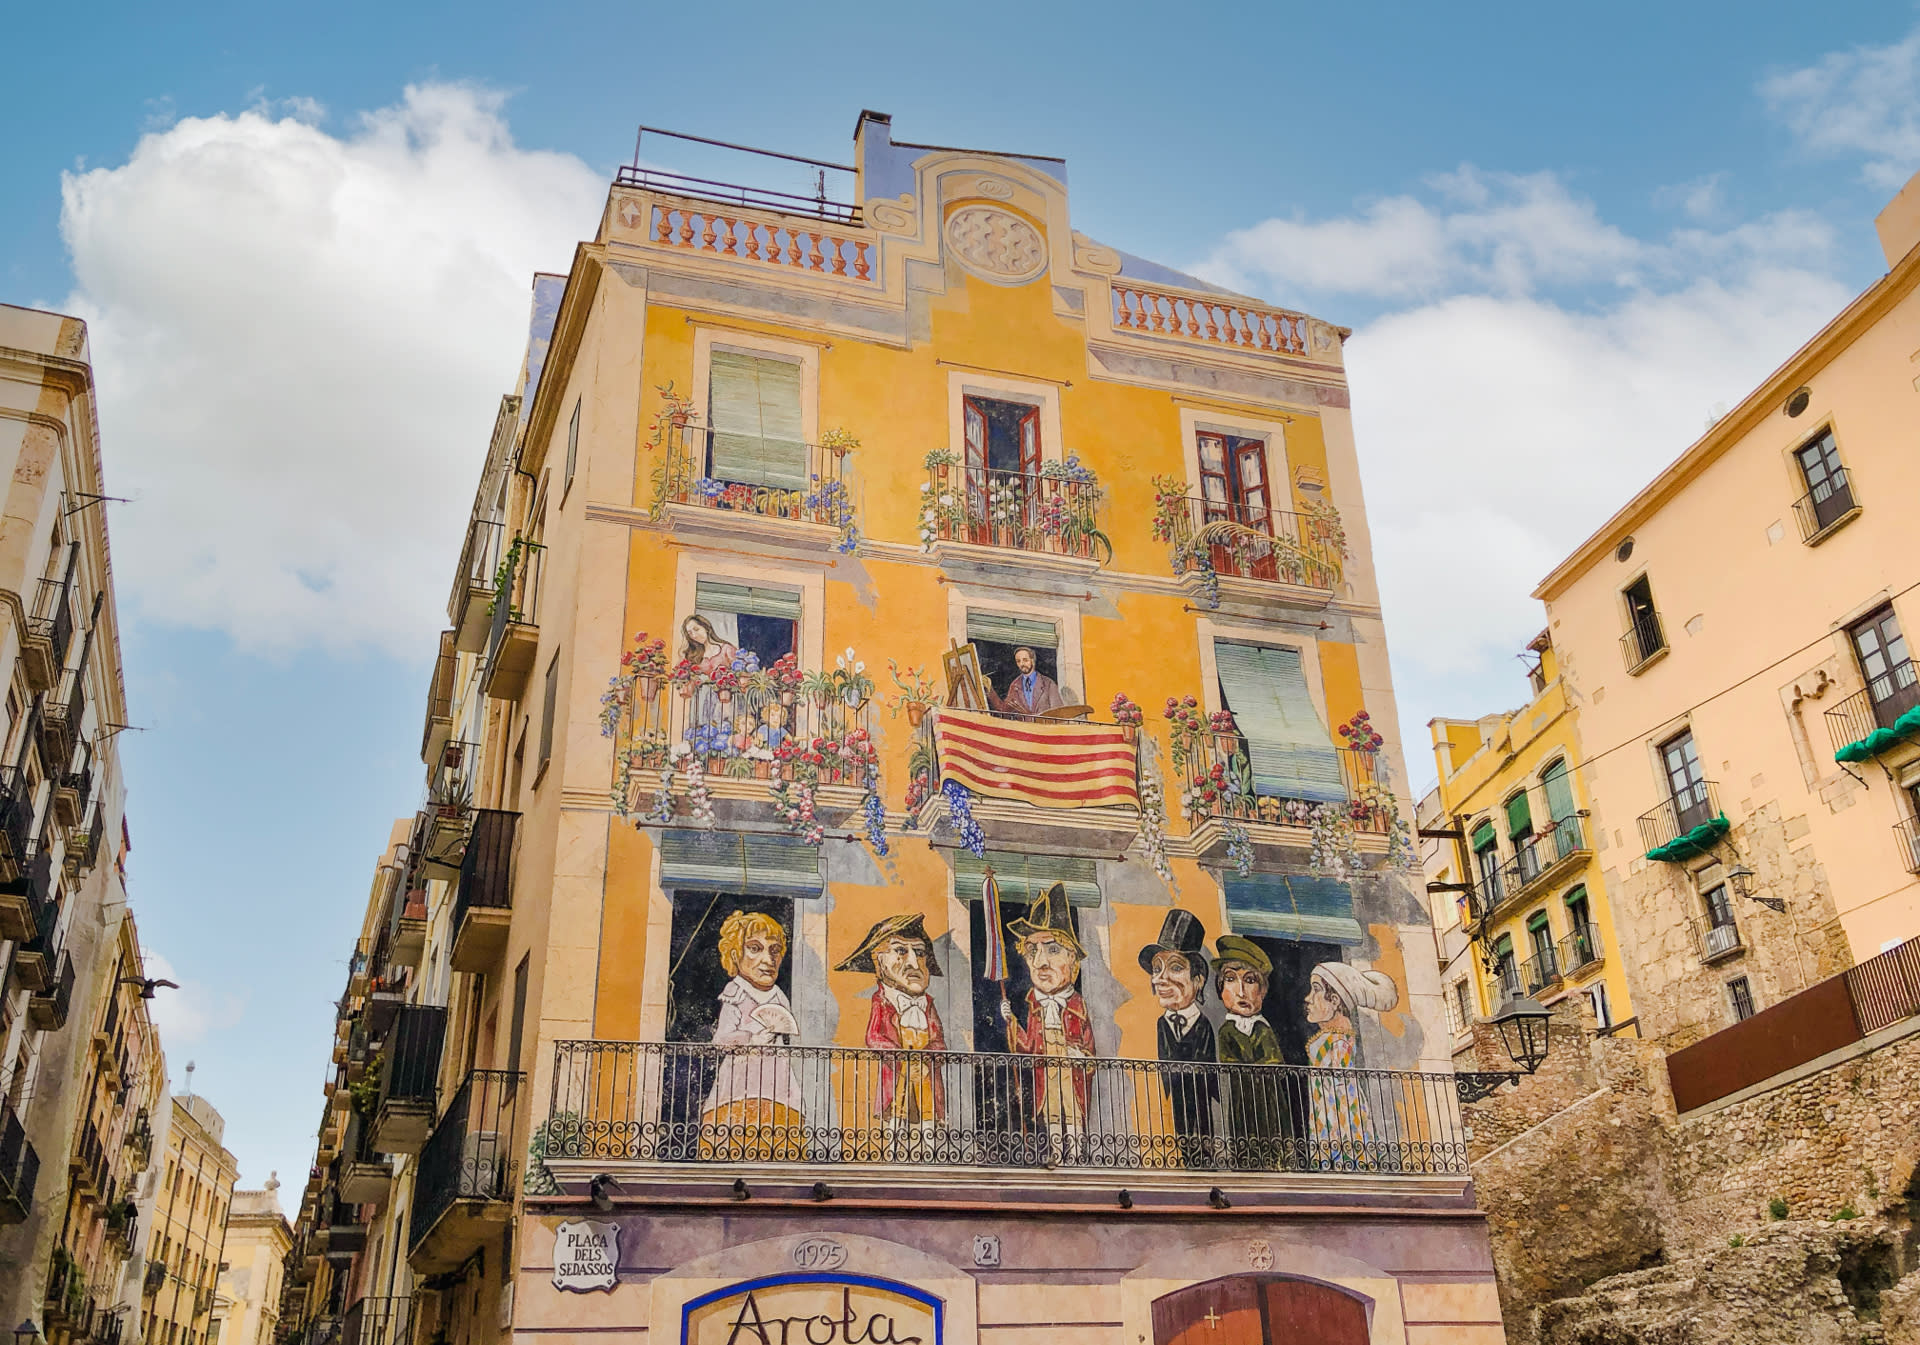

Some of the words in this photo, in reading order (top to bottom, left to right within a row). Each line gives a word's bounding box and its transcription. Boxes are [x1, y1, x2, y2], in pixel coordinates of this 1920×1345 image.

[567, 1233, 608, 1248] PLAÇA
[574, 1248, 602, 1261] DELS
[798, 1244, 843, 1267] 1995
[982, 1242, 992, 1260] 2
[559, 1263, 614, 1277] SEDASSOS
